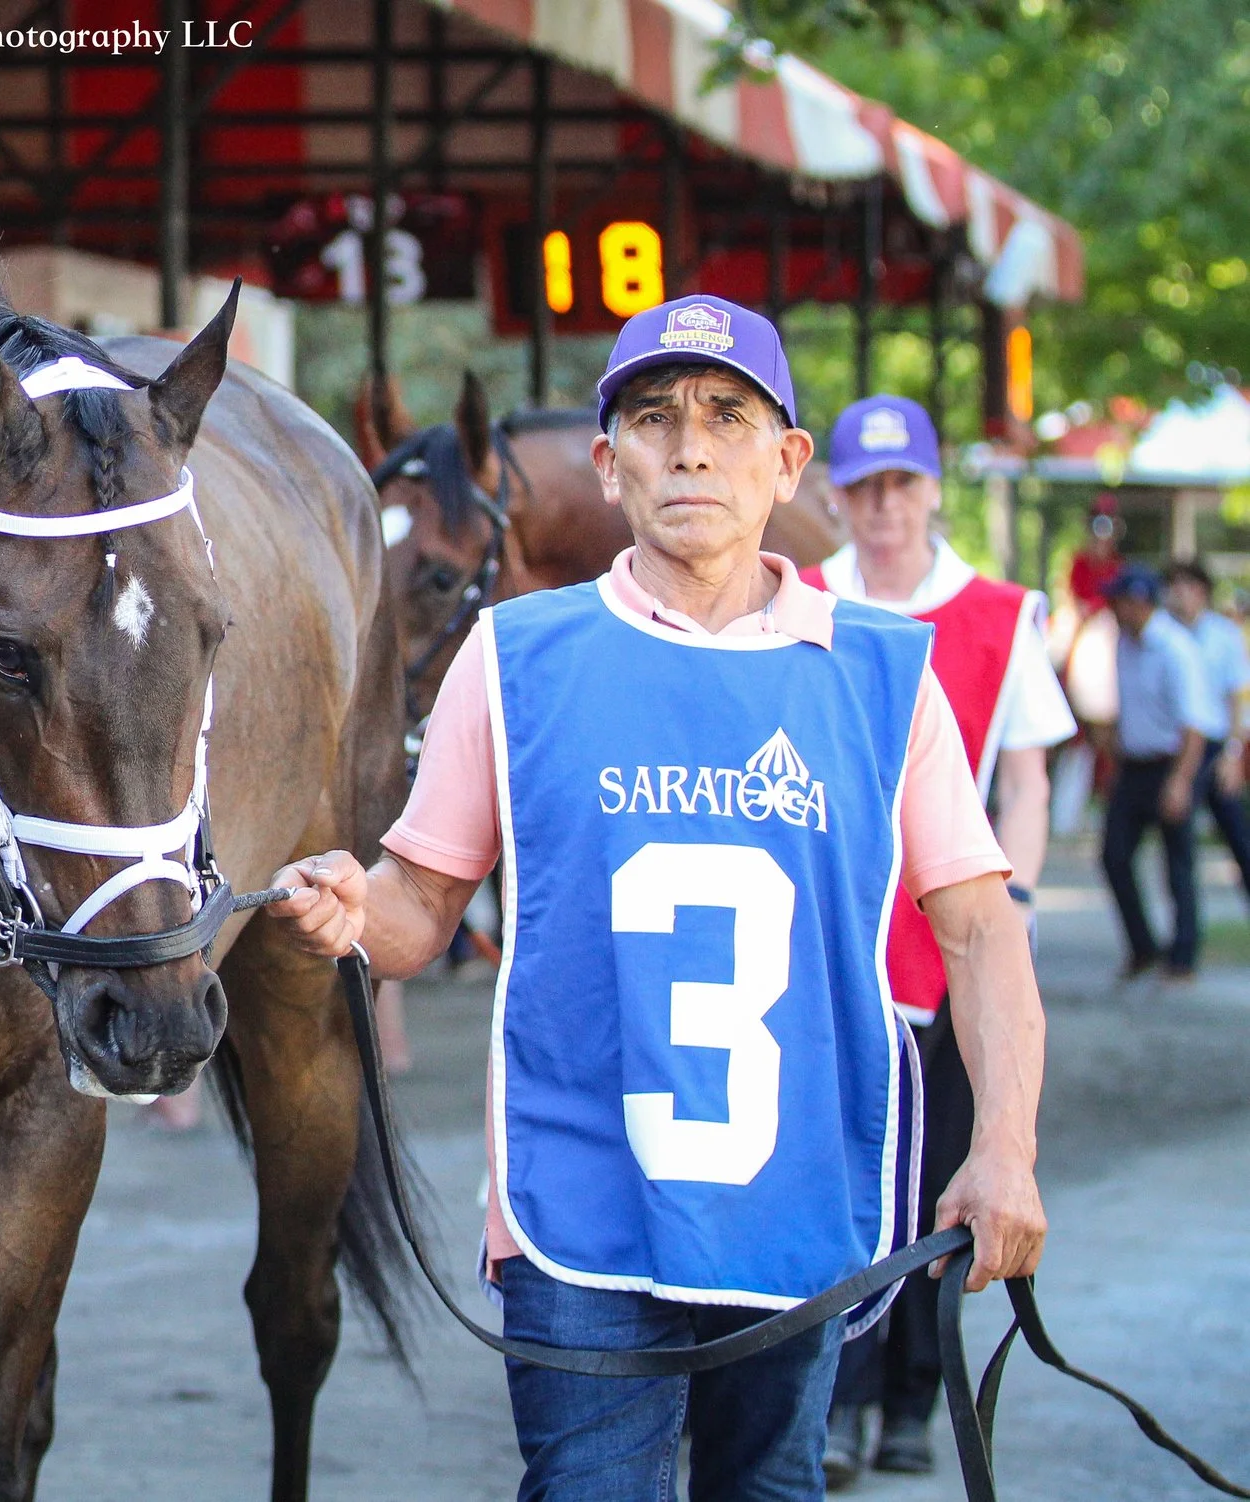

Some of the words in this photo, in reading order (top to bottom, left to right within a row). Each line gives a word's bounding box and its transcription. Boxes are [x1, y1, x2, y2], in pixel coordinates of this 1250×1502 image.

[321, 228, 426, 304] 13
[543, 220, 665, 318] 18
[662, 332, 731, 345] CHALLENGE
[598, 765, 828, 834] SARATOGA
[611, 842, 796, 1186] 3
